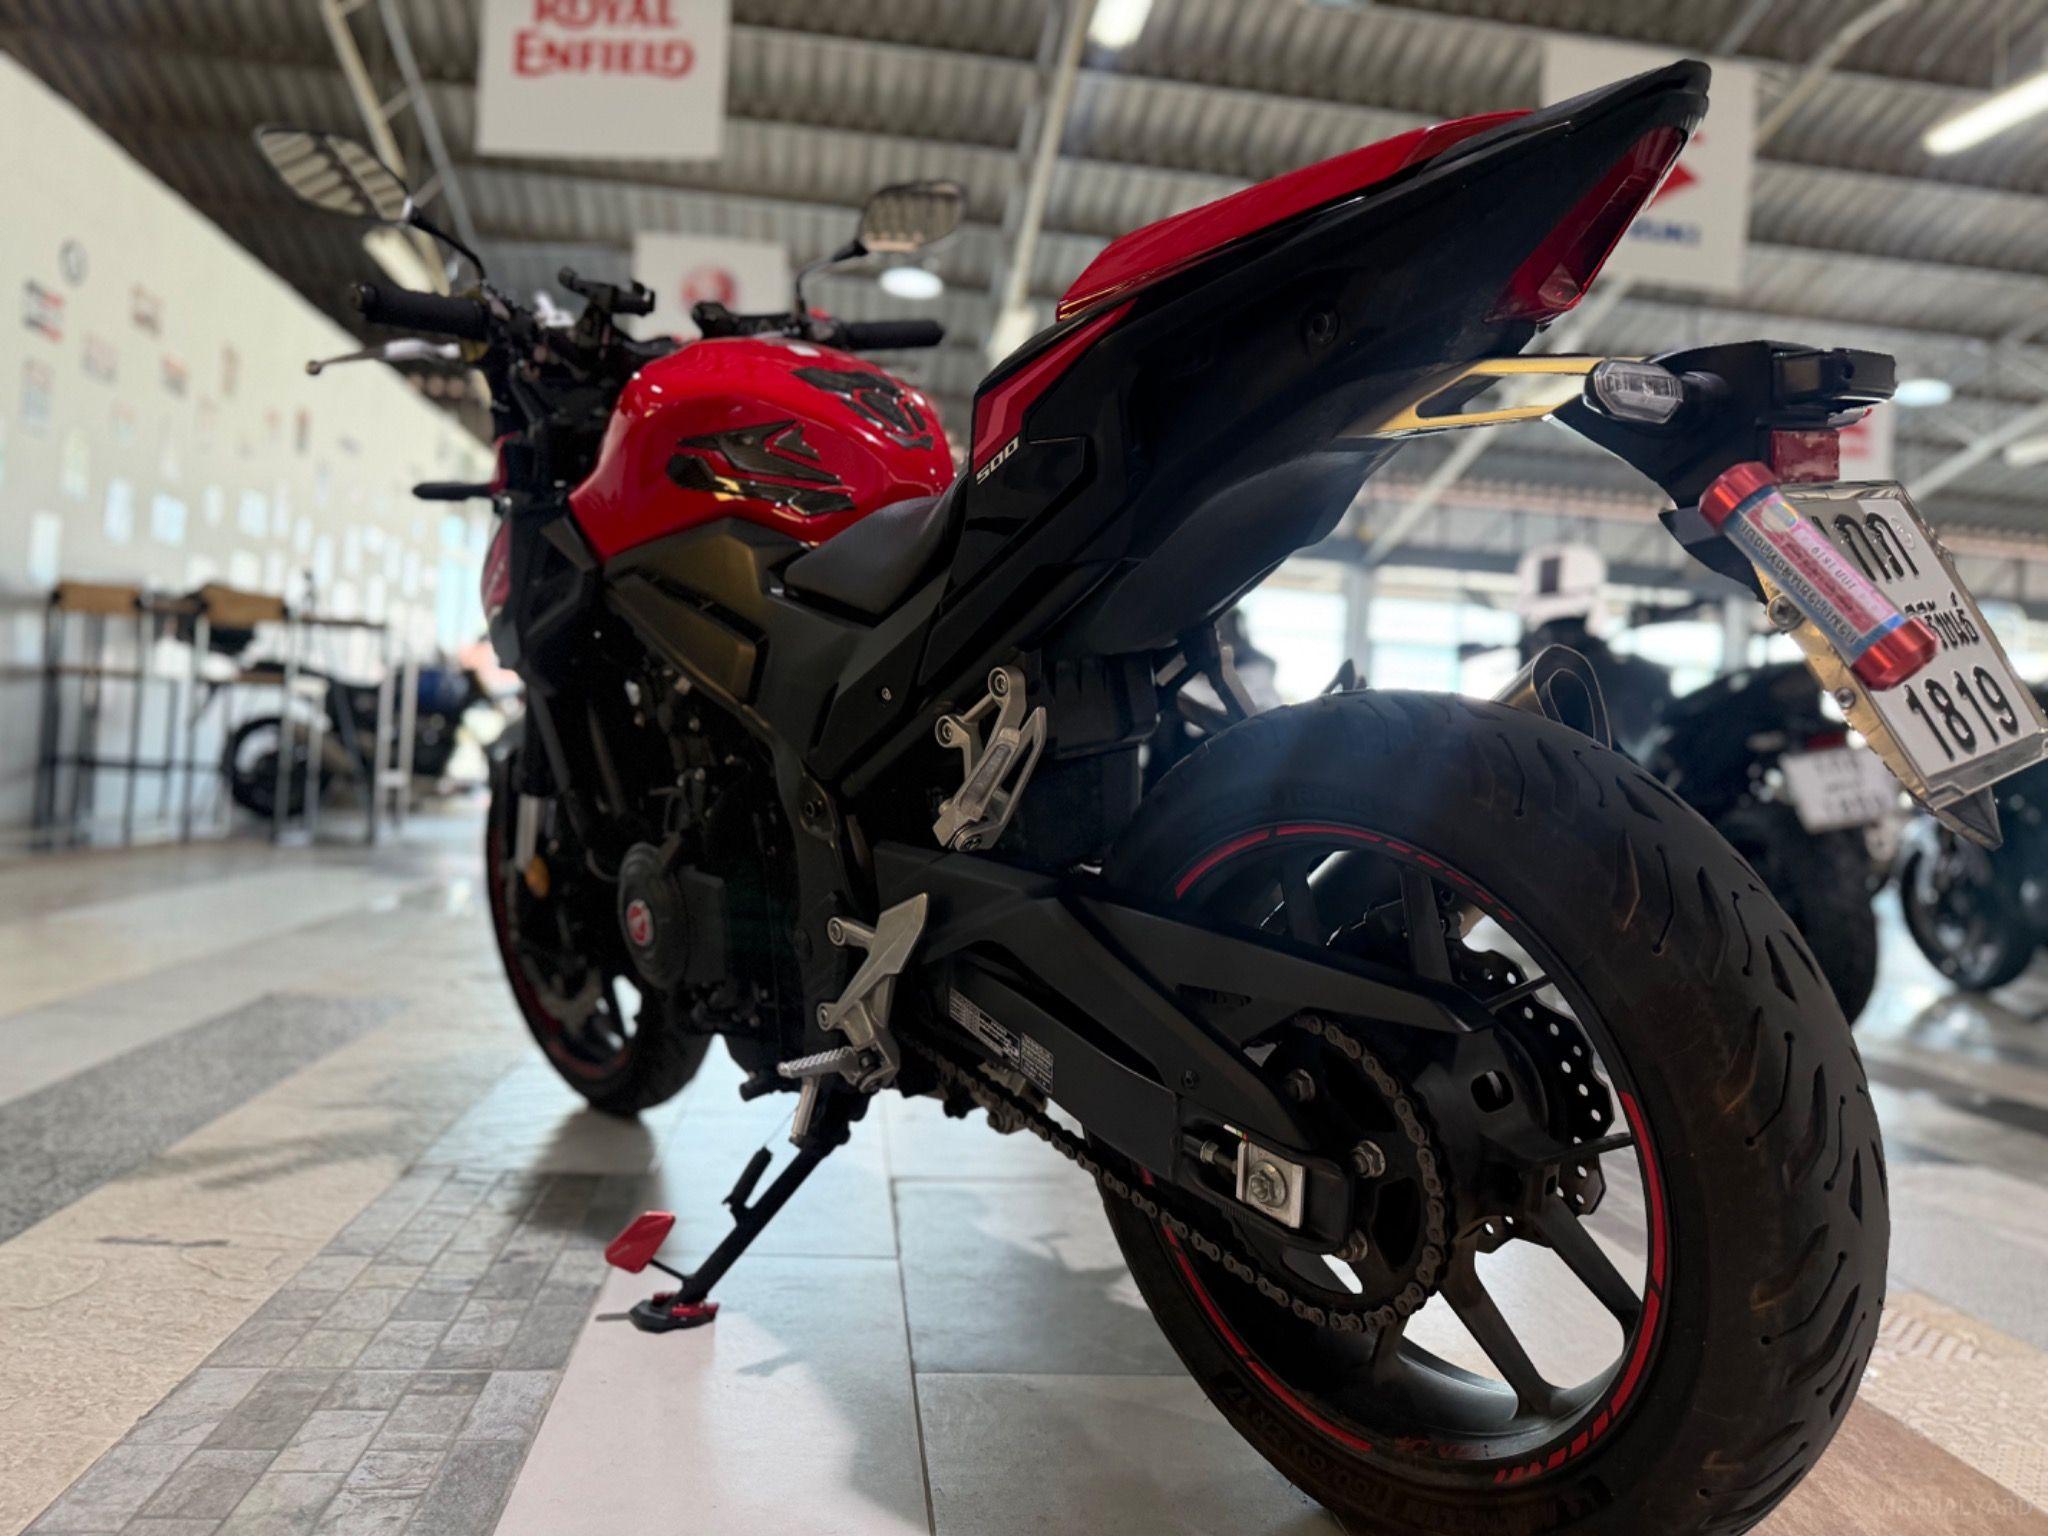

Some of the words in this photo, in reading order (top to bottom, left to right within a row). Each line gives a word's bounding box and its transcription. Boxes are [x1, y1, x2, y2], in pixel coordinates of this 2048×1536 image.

[534, 0, 676, 29] ROYAL
[514, 30, 694, 79] ENFIELD
[976, 436, 1019, 485] 500
[1904, 666, 2018, 762] 1819
